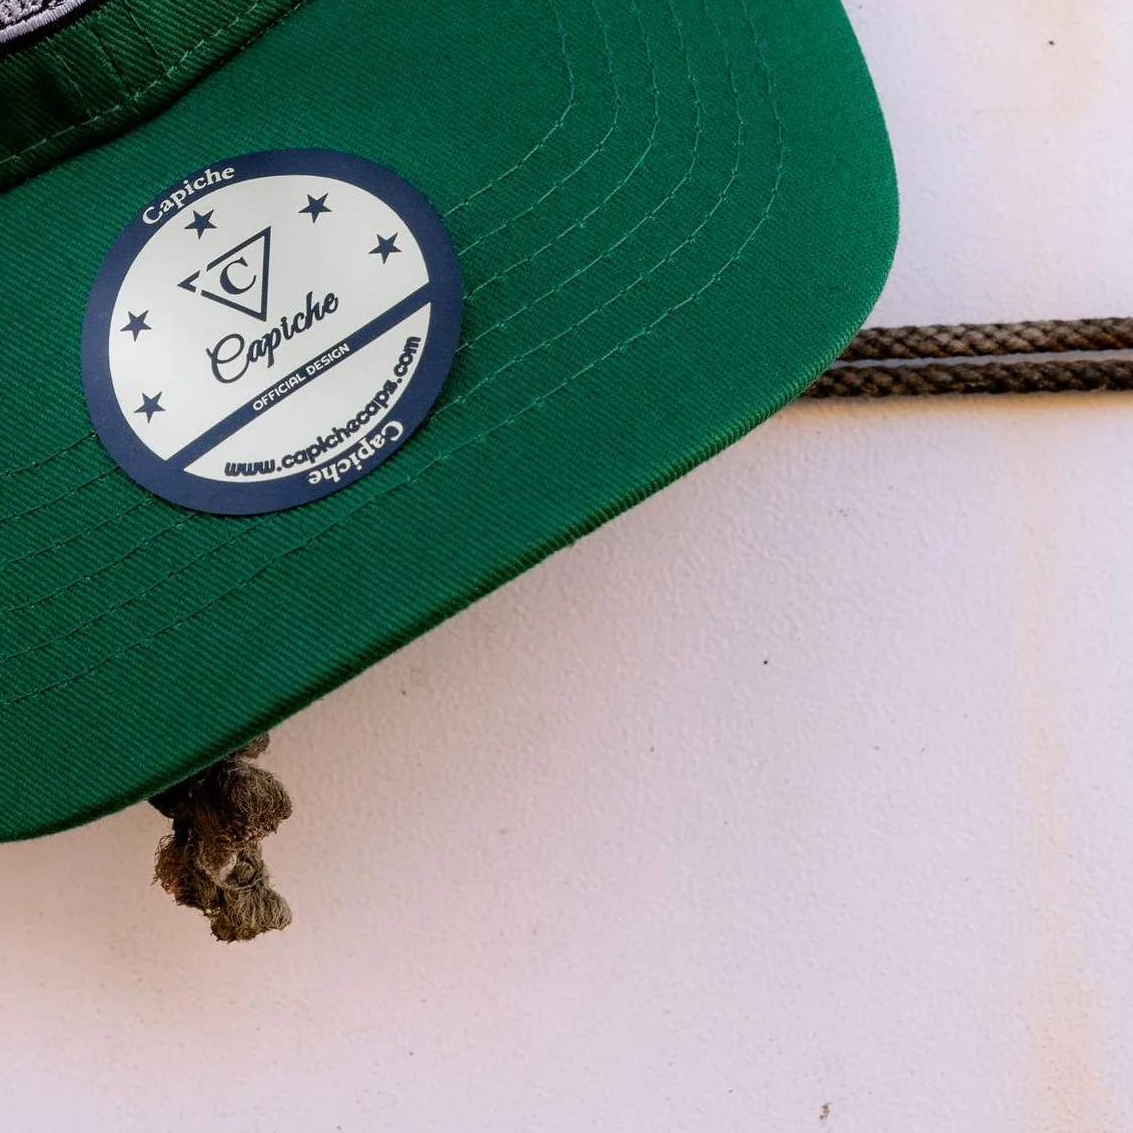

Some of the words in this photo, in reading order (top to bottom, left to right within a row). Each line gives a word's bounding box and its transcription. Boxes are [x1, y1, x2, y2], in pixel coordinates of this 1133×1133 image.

[142, 166, 235, 225] Capiche
[219, 256, 257, 295] C
[206, 290, 339, 384] Capiche
[223, 335, 422, 477] www.capichecaps.com
[252, 373, 306, 412] OFFICIAL
[305, 342, 351, 376] DESIGN
[308, 420, 404, 485] Capiche
